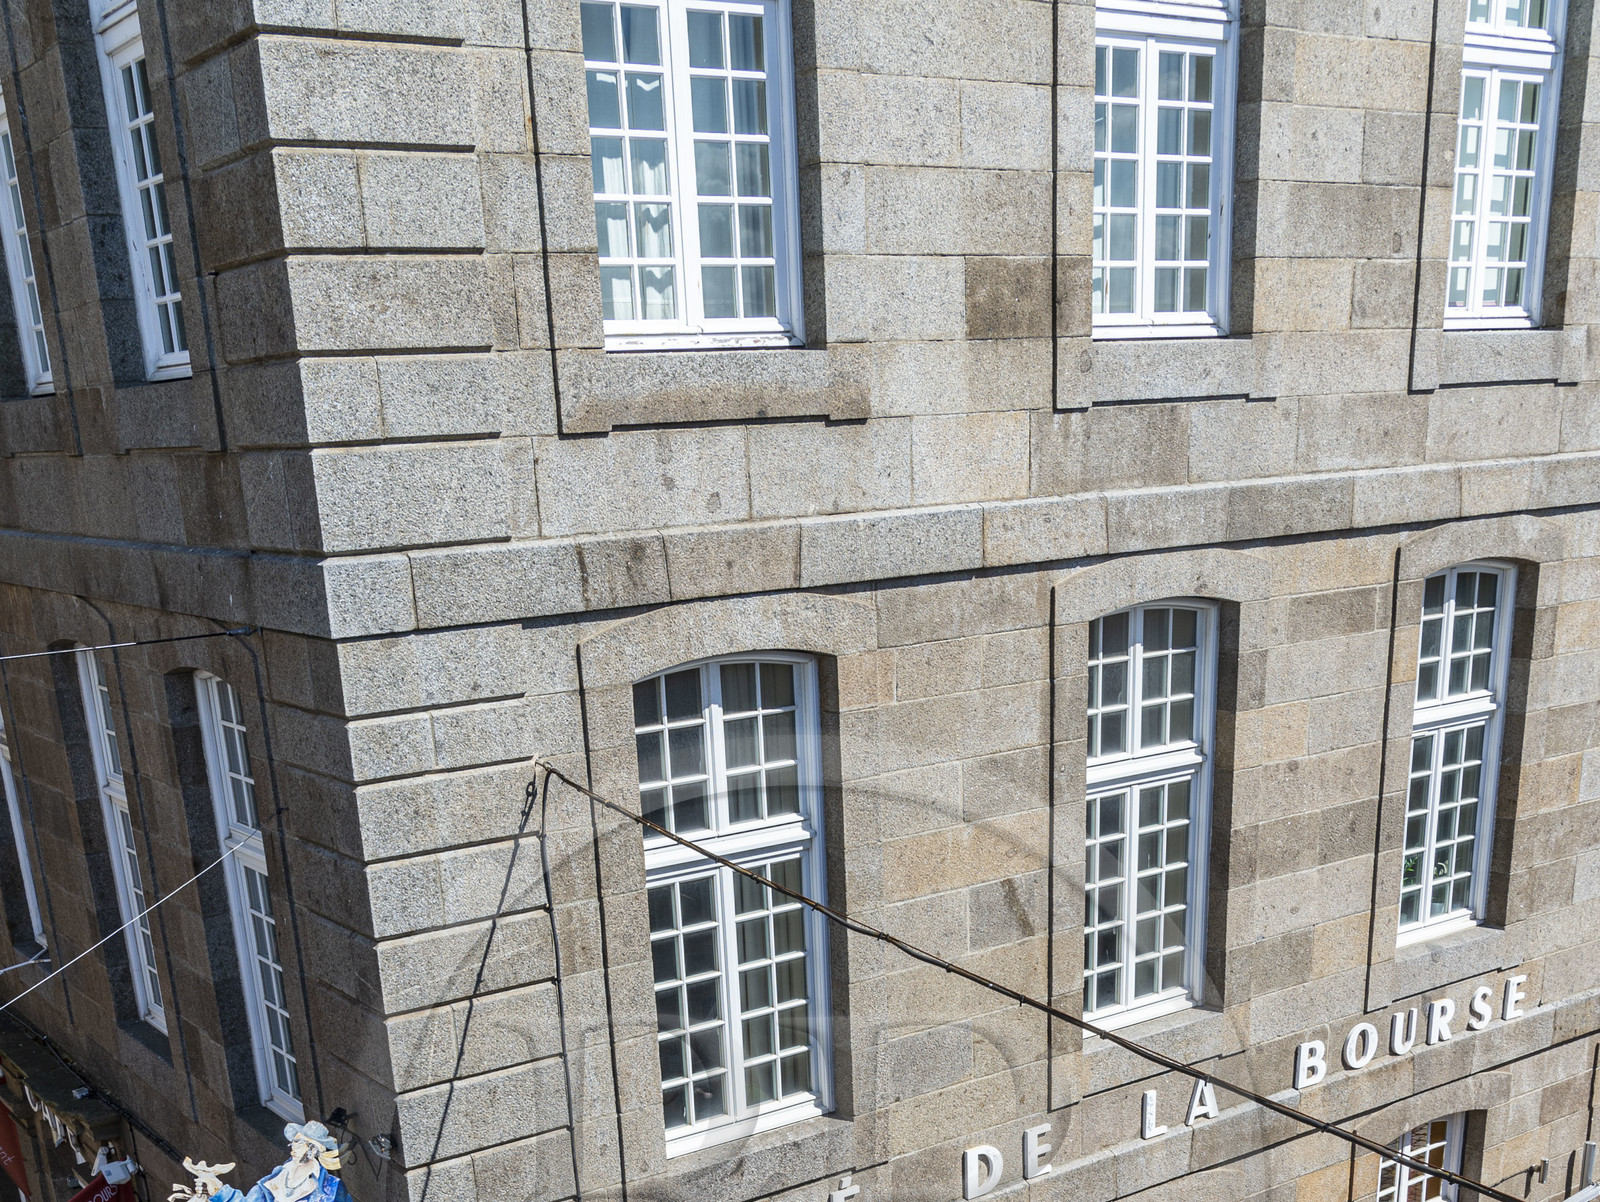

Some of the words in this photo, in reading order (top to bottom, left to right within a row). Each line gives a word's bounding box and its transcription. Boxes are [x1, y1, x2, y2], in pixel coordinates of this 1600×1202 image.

[963, 1123, 1053, 1199] DE
[1141, 1079, 1220, 1140] LA
[1294, 973, 1528, 1090] BOURSE
